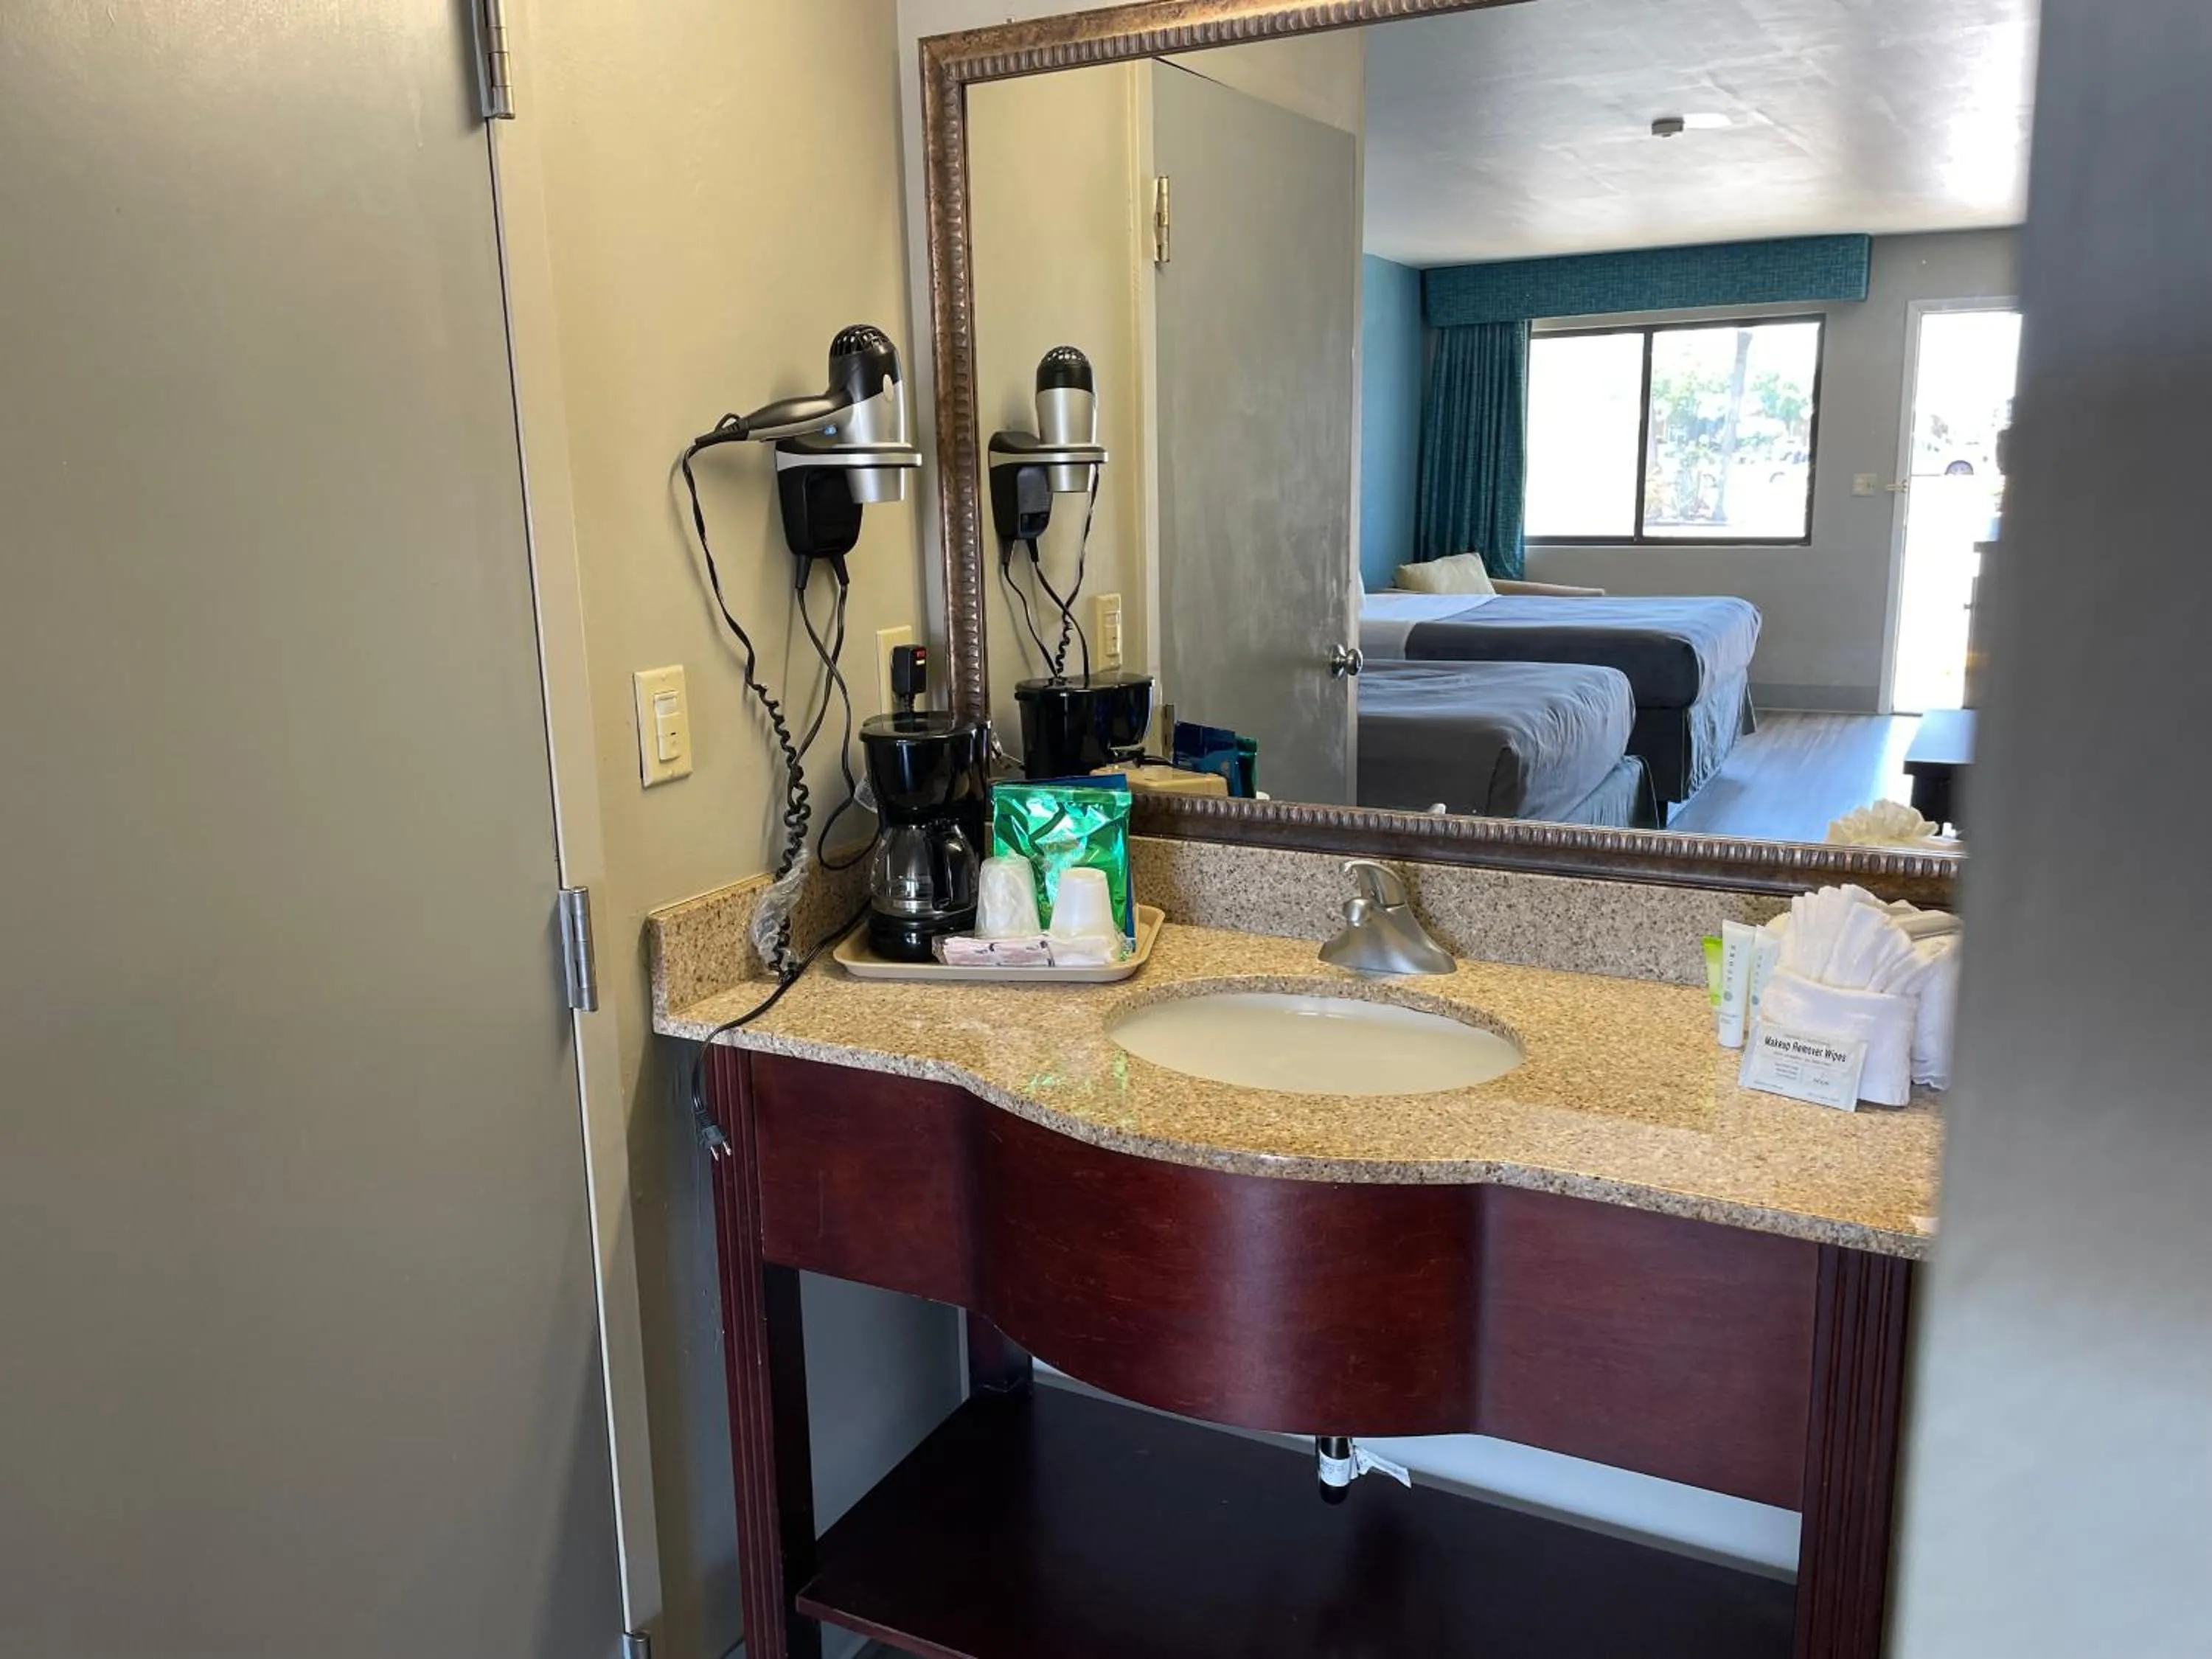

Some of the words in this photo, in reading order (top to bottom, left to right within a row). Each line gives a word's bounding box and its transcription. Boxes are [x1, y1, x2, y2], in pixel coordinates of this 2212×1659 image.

[1764, 1035, 1791, 1052] Makeup
[1792, 1041, 1823, 1057] Remover
[1825, 1048, 1847, 1062] Wipes
